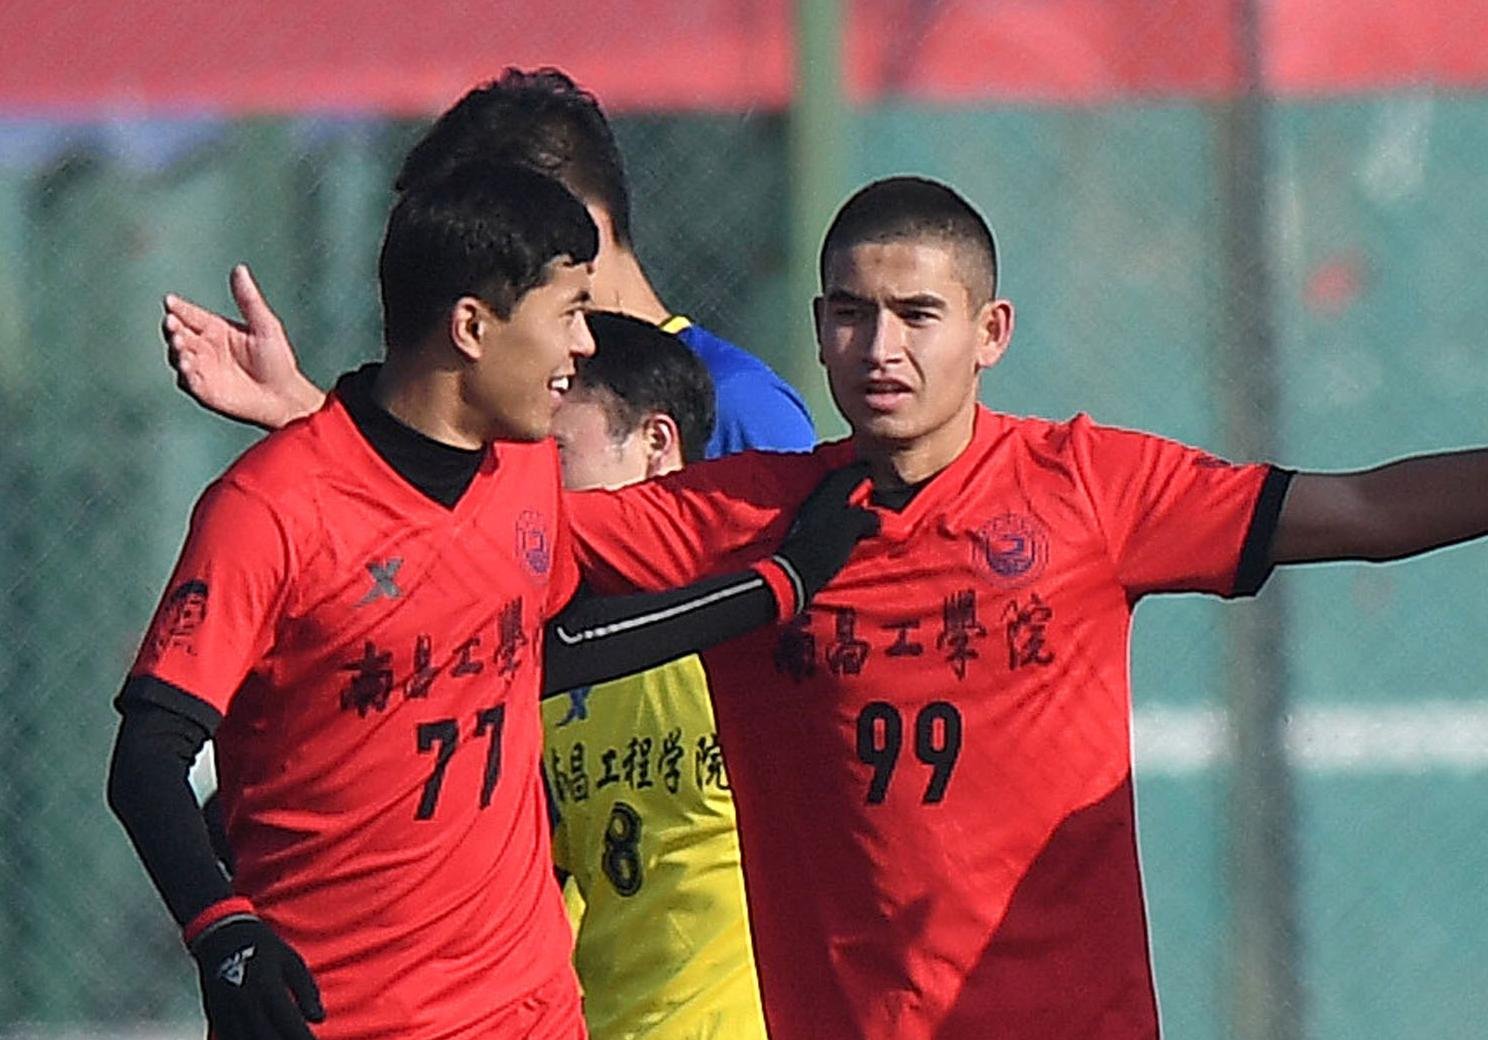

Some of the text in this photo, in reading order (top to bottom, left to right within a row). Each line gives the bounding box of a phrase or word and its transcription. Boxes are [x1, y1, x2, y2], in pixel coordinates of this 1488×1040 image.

[339, 595, 544, 720] 南昌工學
[414, 703, 505, 822] 77
[856, 700, 962, 805] 99
[602, 801, 644, 897] 8
